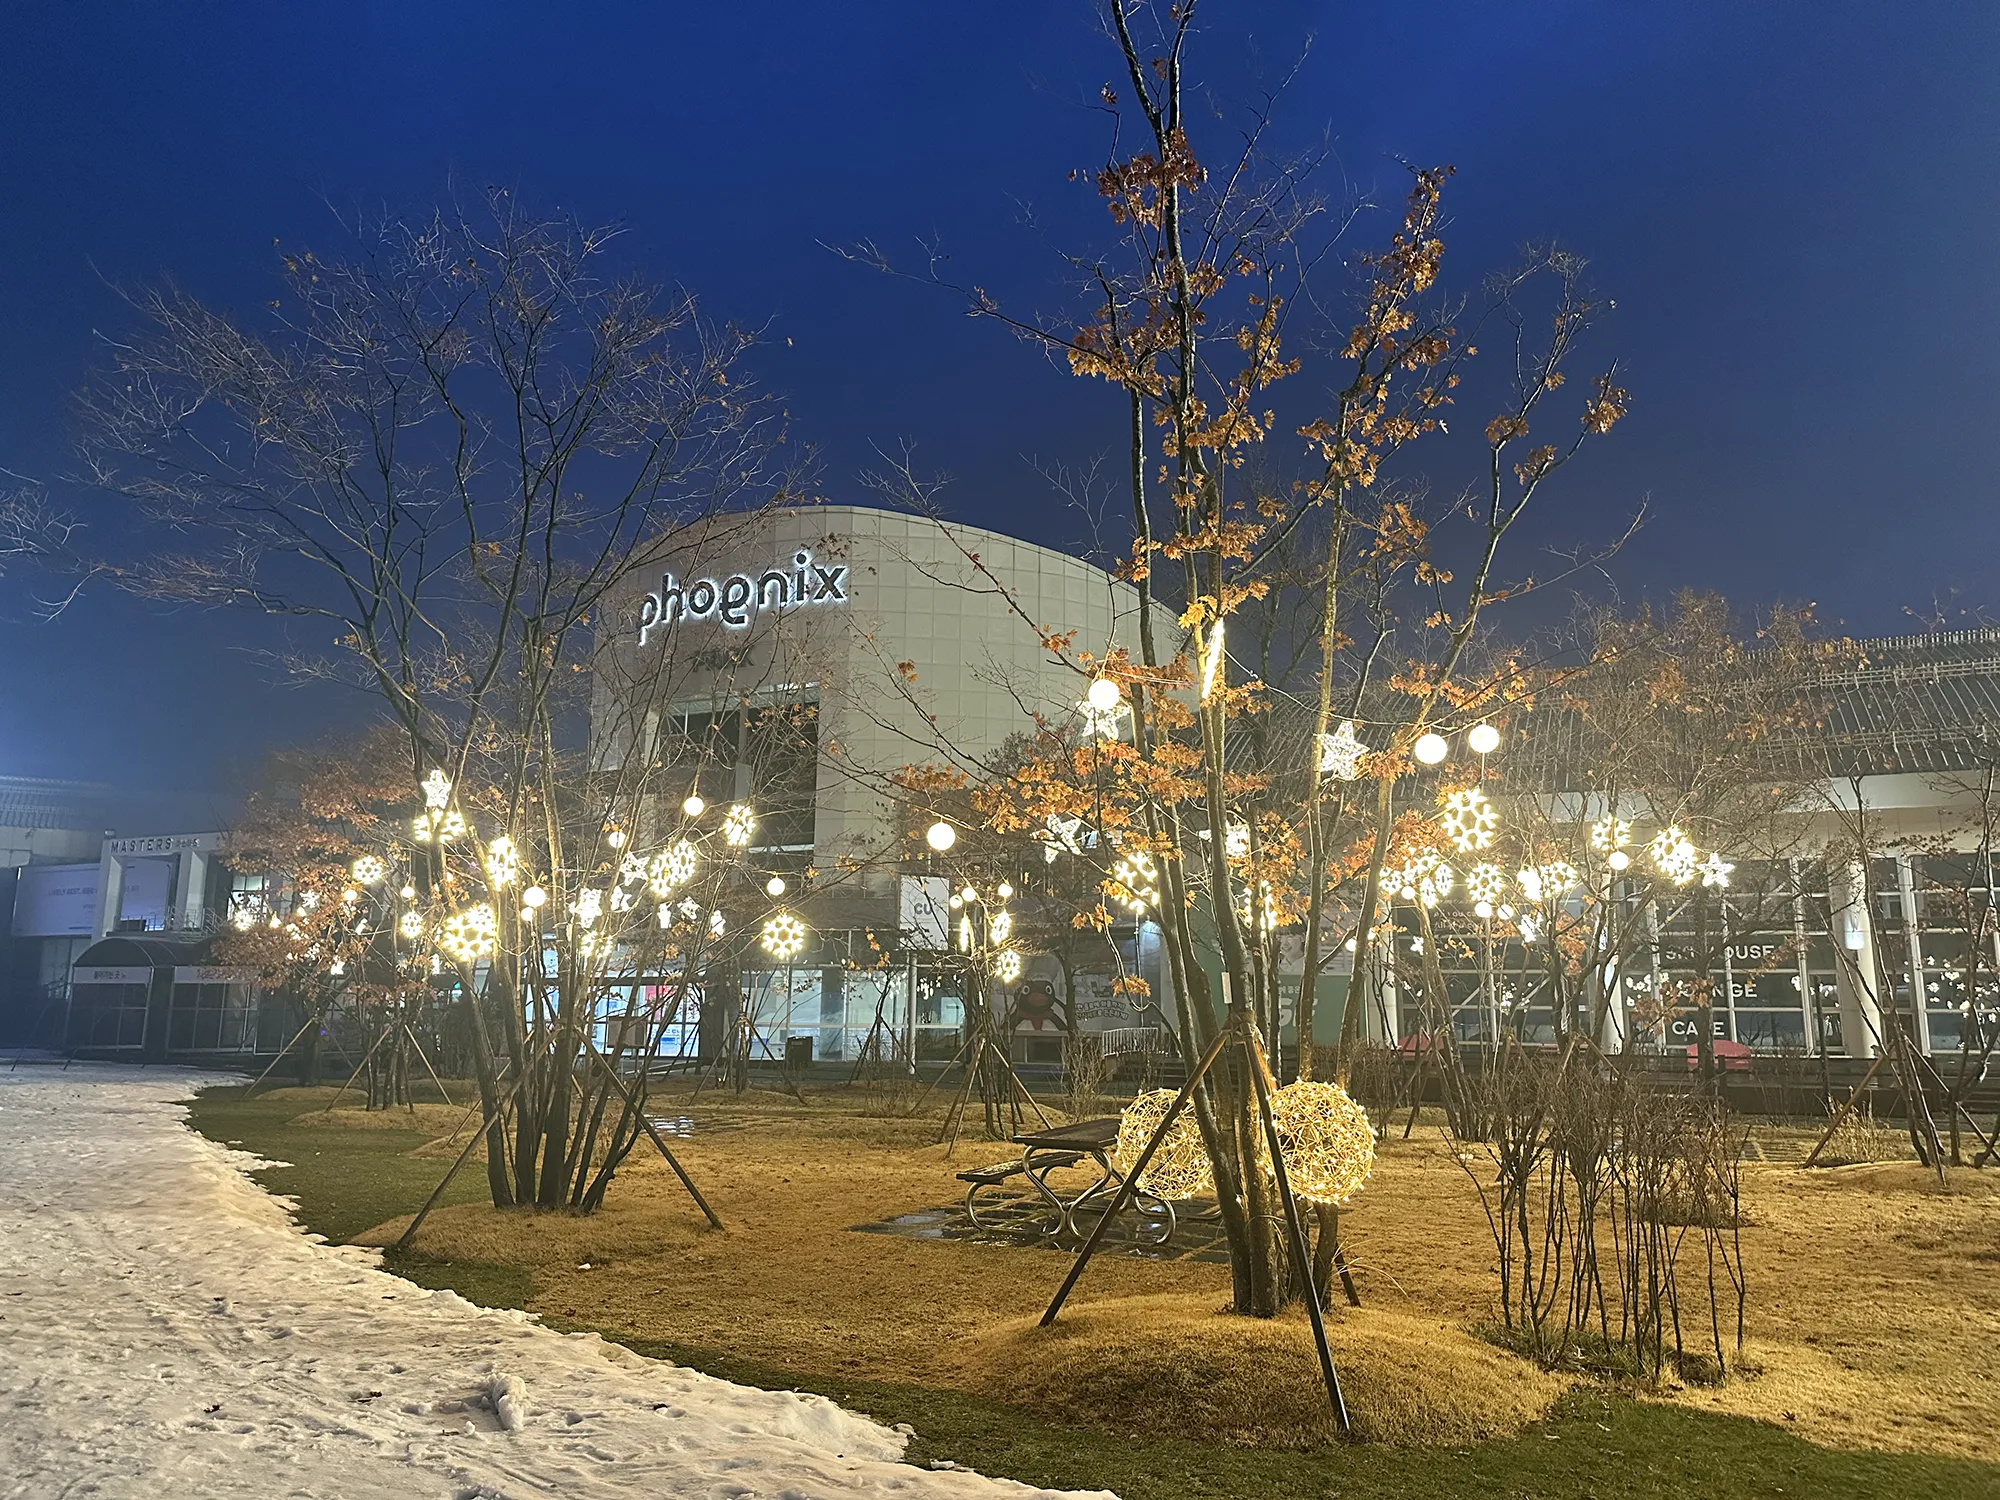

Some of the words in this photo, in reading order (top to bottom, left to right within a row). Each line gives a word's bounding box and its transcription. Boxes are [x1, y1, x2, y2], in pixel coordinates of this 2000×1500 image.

[638, 551, 848, 647] phoenix
[111, 837, 172, 853] MASTERS
[914, 903, 932, 915] CU
[1672, 1021, 1725, 1035] CAE
